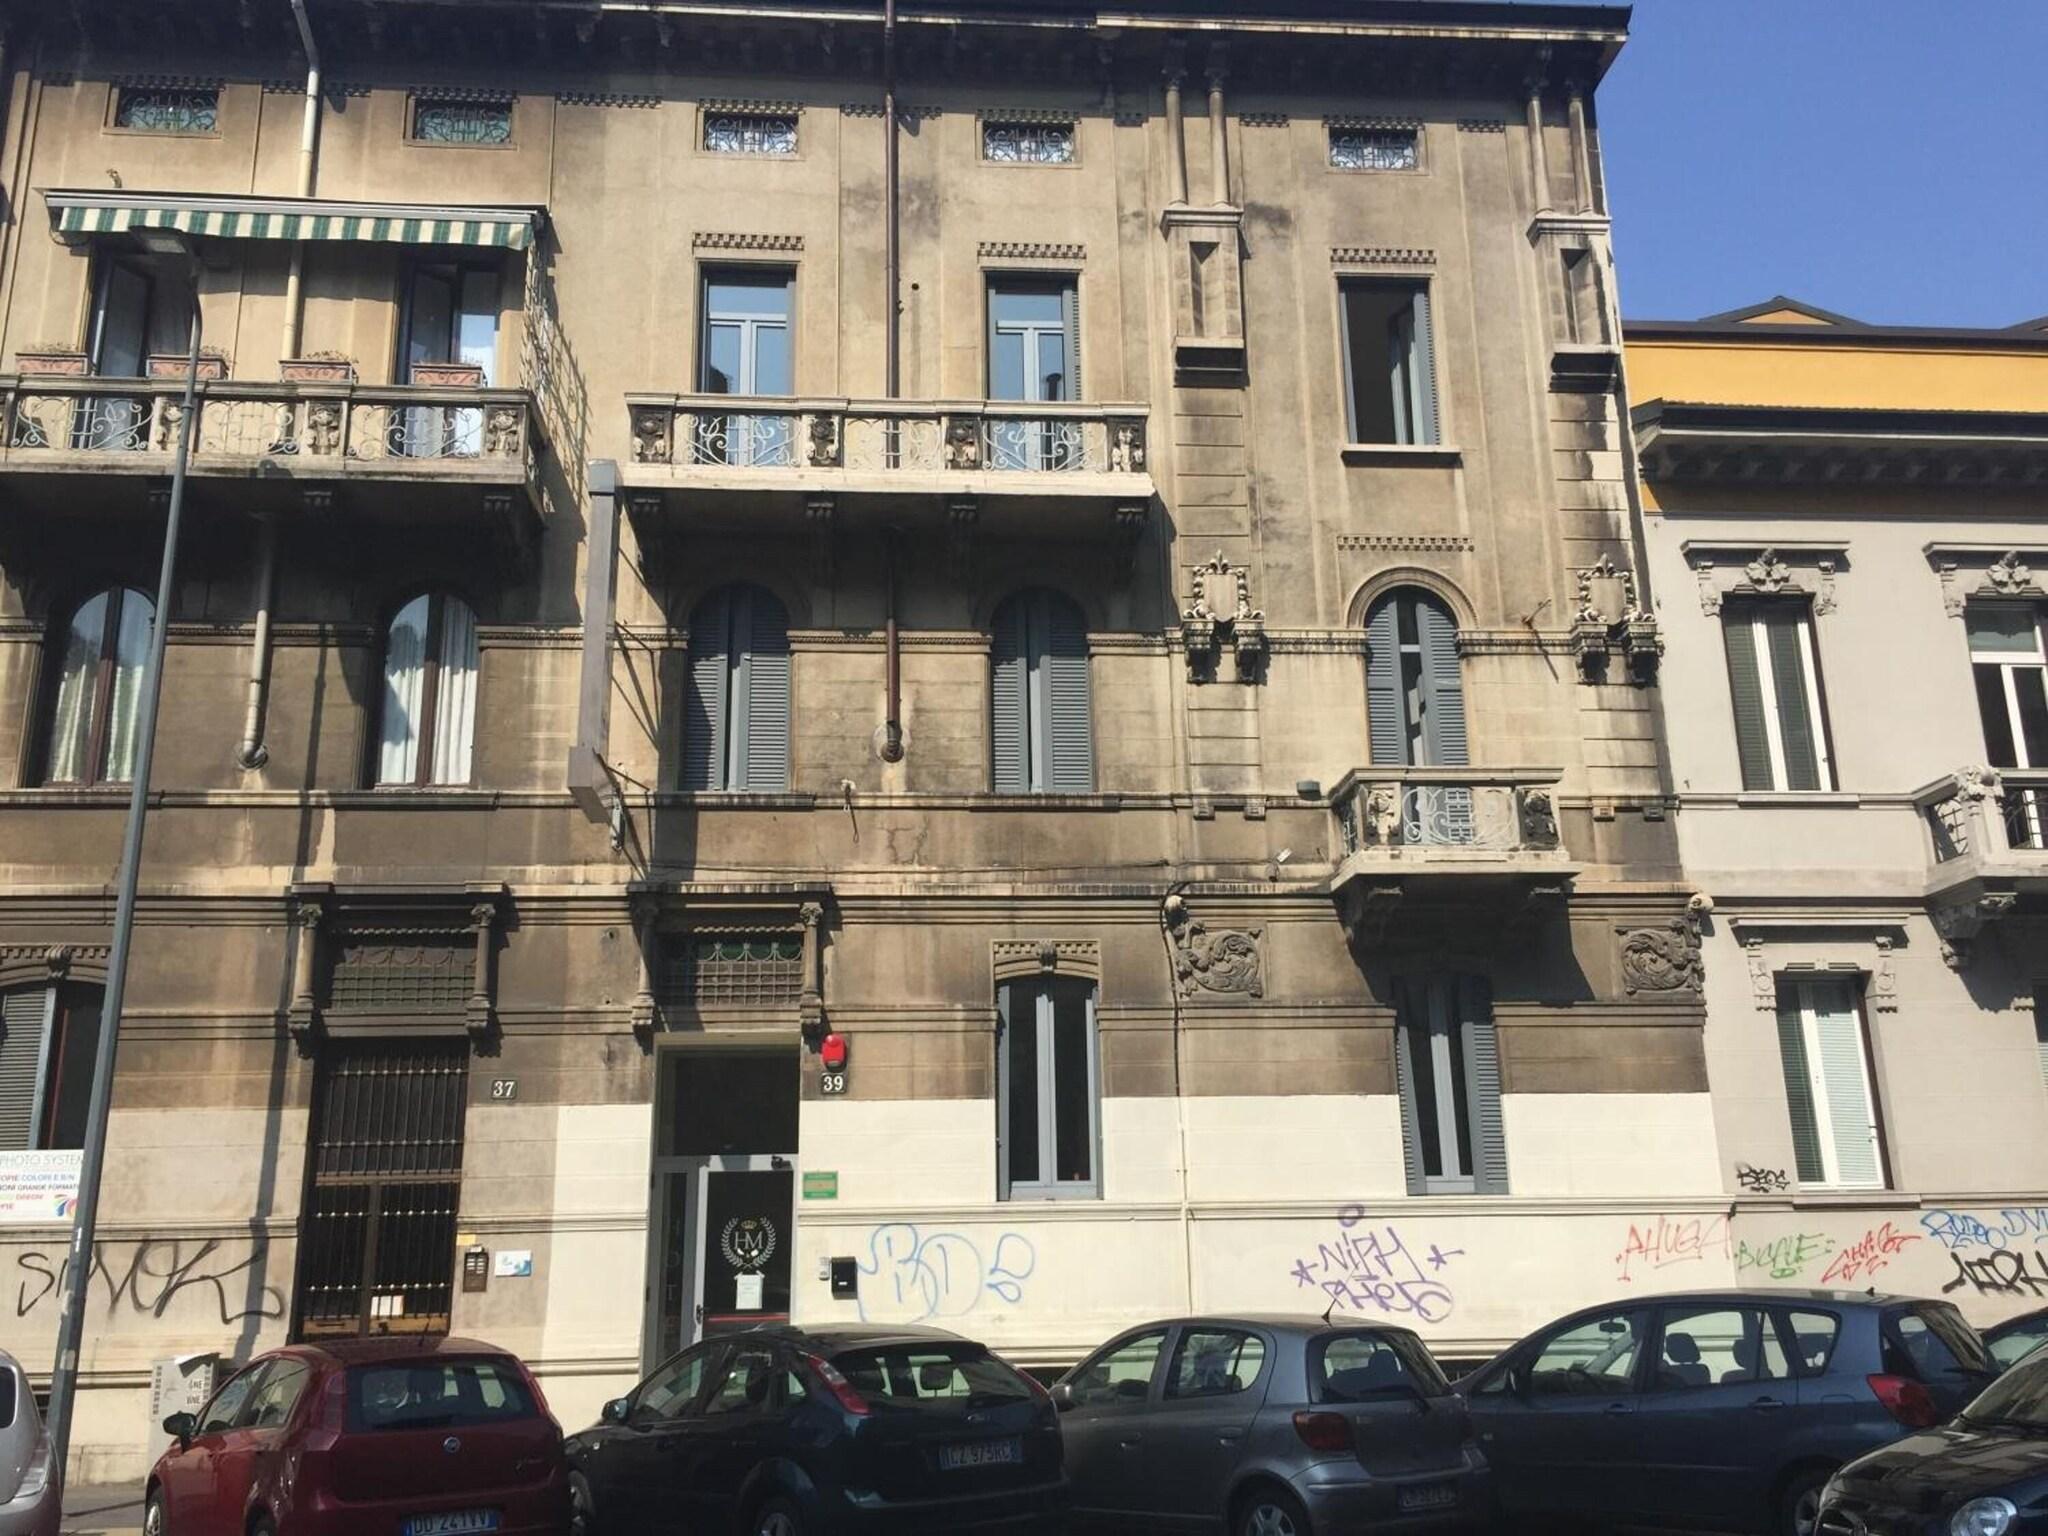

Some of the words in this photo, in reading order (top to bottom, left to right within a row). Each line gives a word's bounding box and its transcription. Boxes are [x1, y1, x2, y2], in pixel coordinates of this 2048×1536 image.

[493, 1080, 515, 1097] 37
[823, 1075, 844, 1092] 39
[734, 1231, 763, 1250] HM
